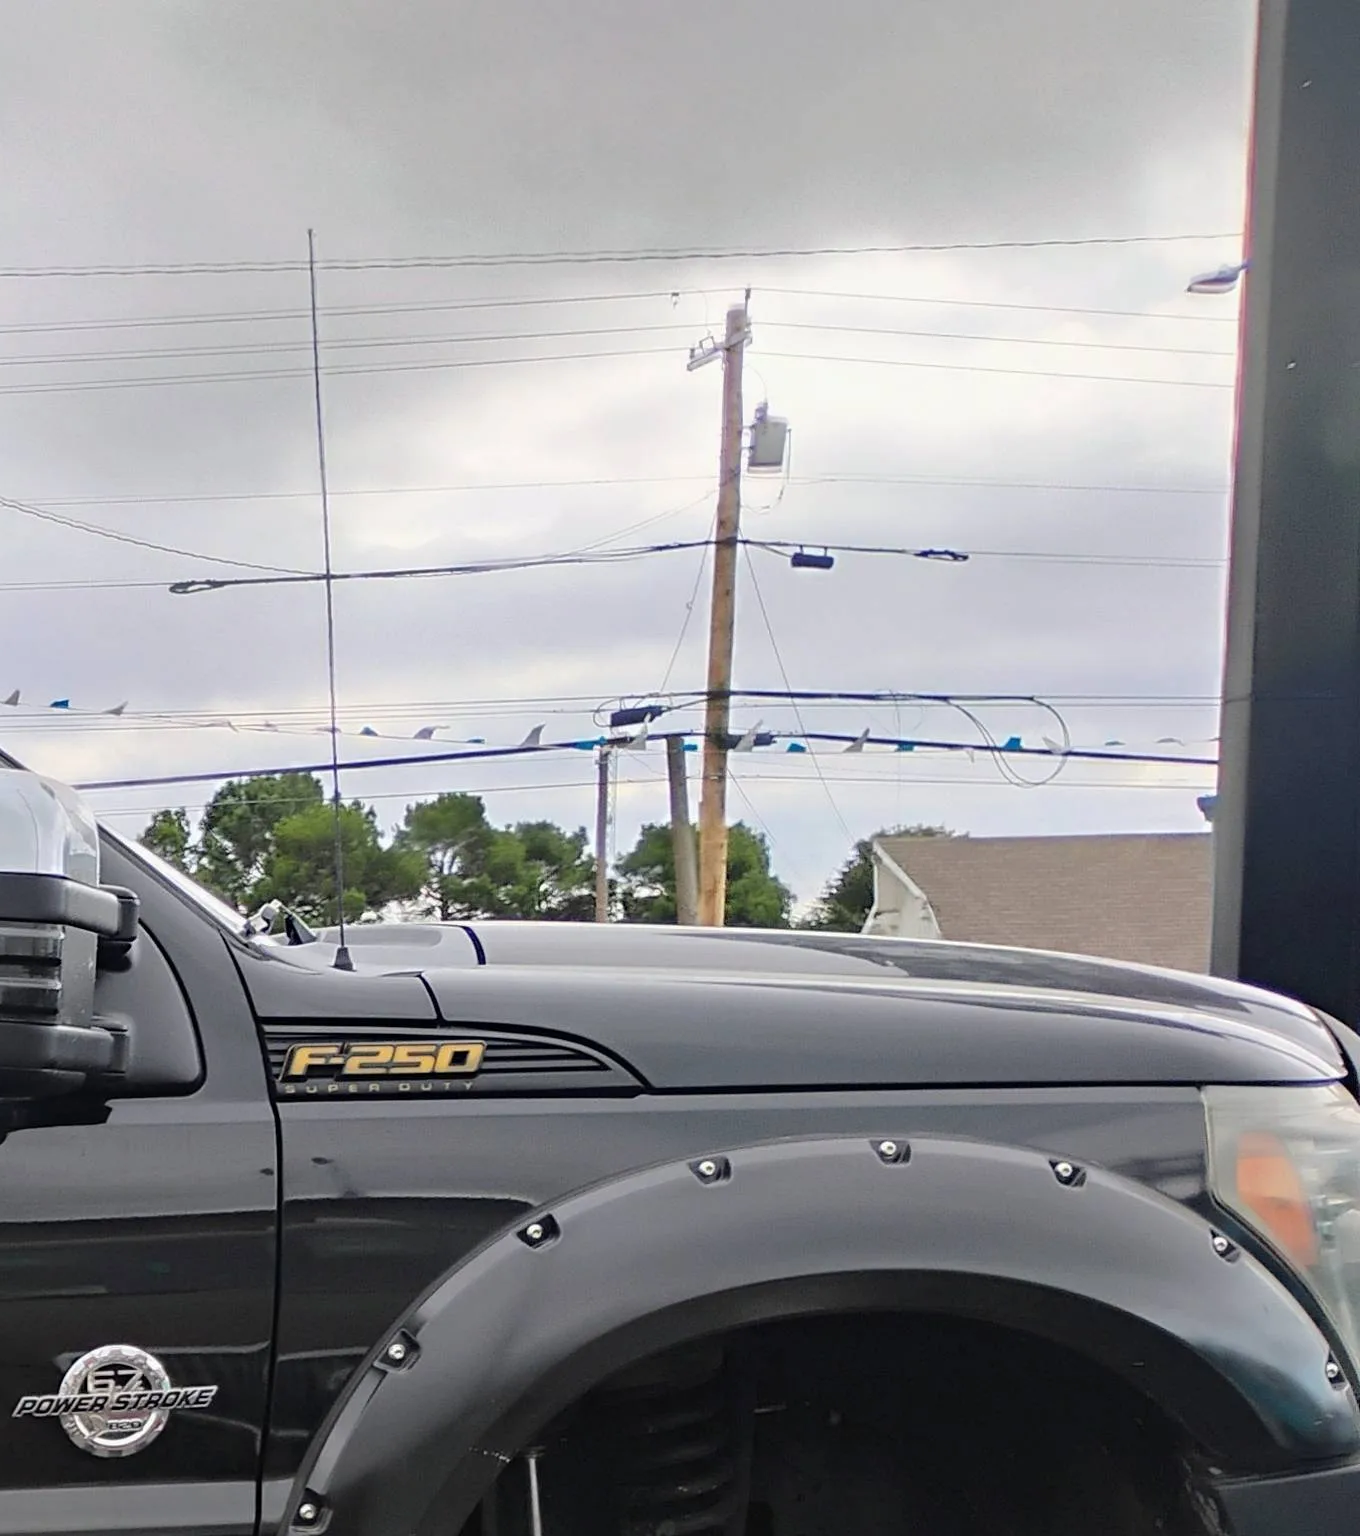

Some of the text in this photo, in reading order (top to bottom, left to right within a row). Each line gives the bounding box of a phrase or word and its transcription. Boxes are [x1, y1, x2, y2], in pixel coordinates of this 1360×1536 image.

[283, 1040, 487, 1079] F-250
[284, 1081, 478, 1094] SUPER DUTY
[14, 1387, 218, 1417] POWER STROKE
